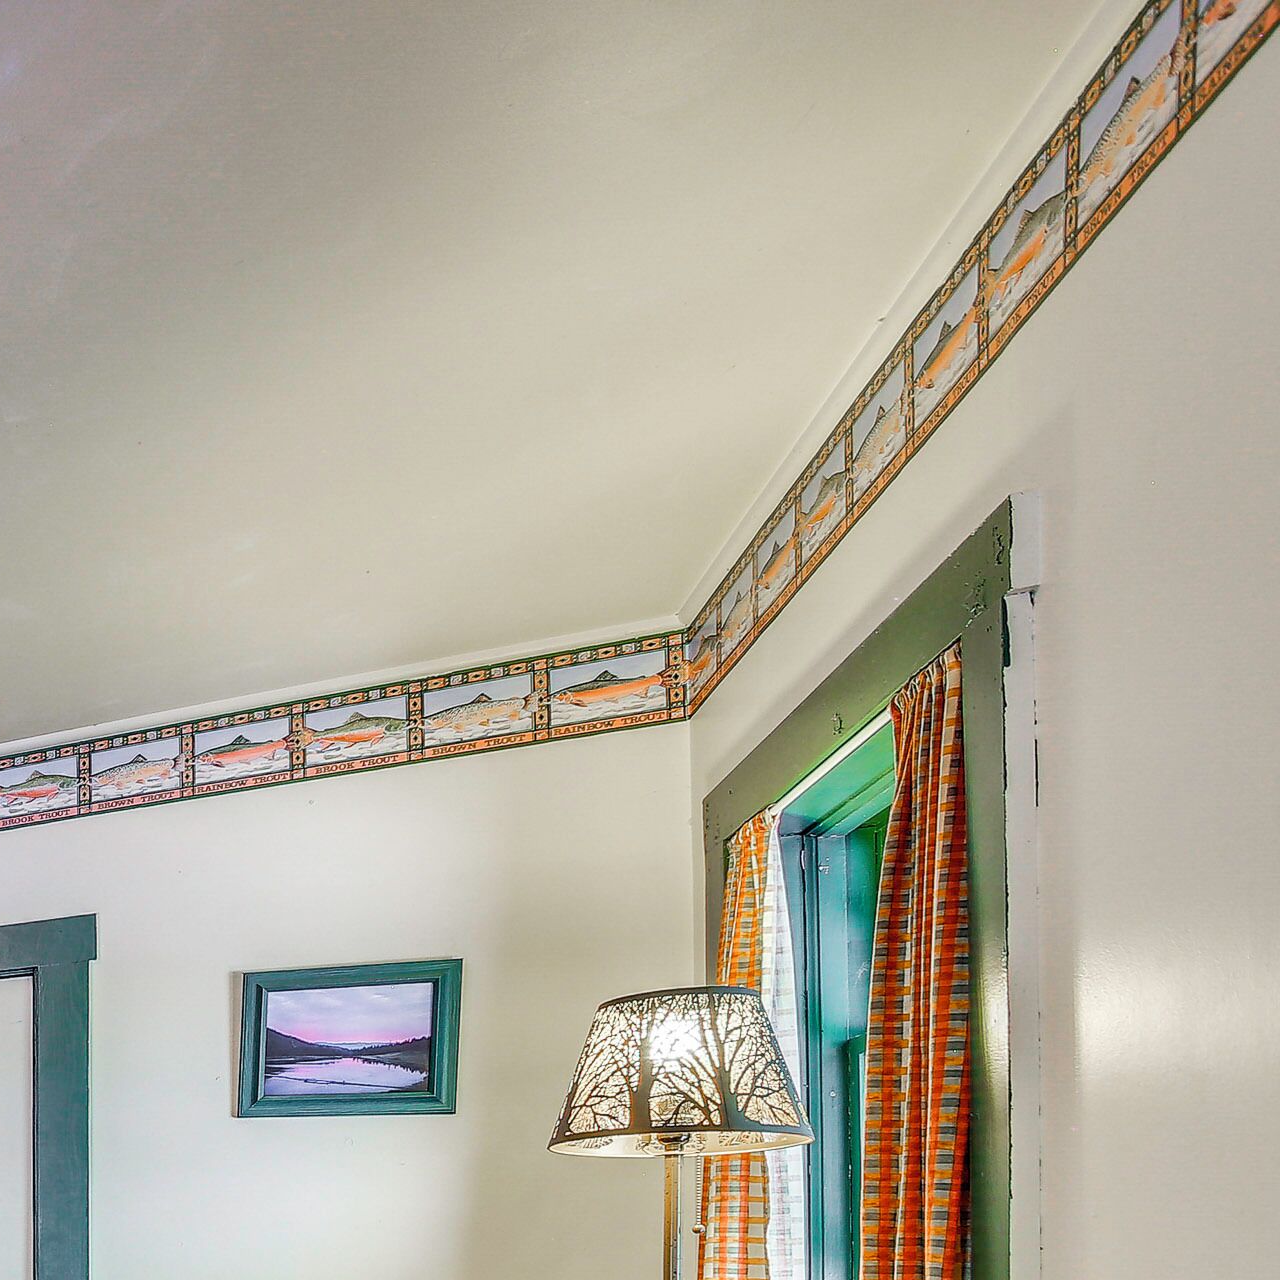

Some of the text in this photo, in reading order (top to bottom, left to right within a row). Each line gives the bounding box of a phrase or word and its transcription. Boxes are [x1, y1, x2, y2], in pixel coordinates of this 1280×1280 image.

[1082, 129, 1169, 240] BROWN TROUT
[553, 712, 666, 736] RAINBOW TROUT
[432, 734, 526, 756] BROWN TROUT
[314, 754, 400, 775] BROOK TROUT
[196, 772, 289, 794] RAINBOW TROUT
[97, 791, 175, 810] BROWN TROUT
[1, 809, 71, 827] BROOK TROUT
